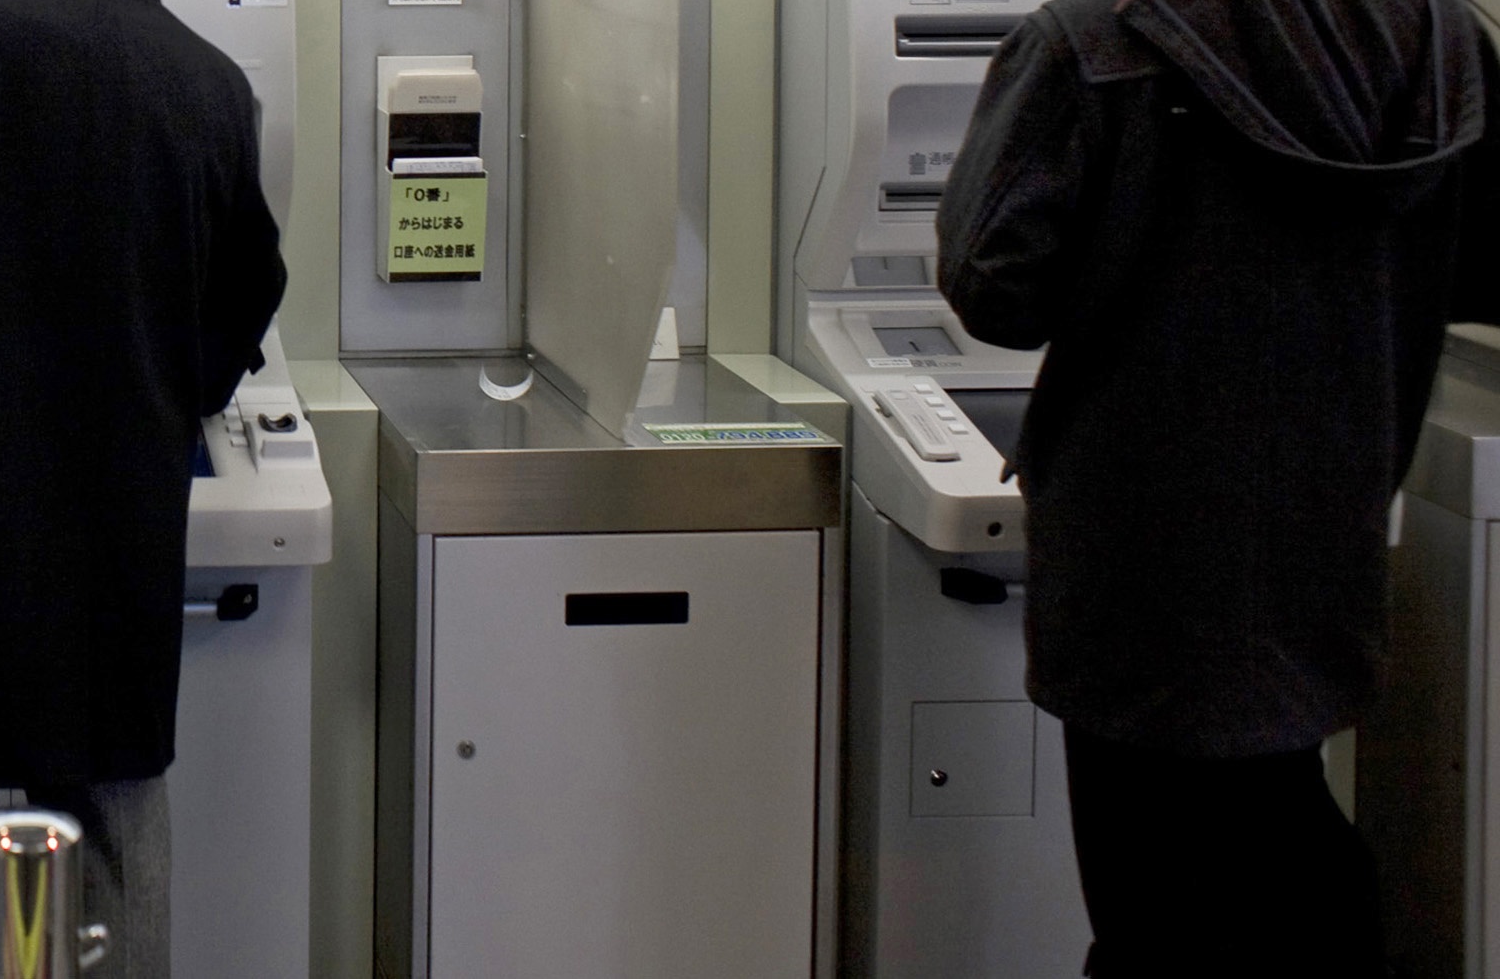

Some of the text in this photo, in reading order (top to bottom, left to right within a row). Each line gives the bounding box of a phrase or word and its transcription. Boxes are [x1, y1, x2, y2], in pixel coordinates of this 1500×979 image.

[399, 216, 464, 230] からはじまる
[394, 244, 475, 258] 口座への送金用紙
